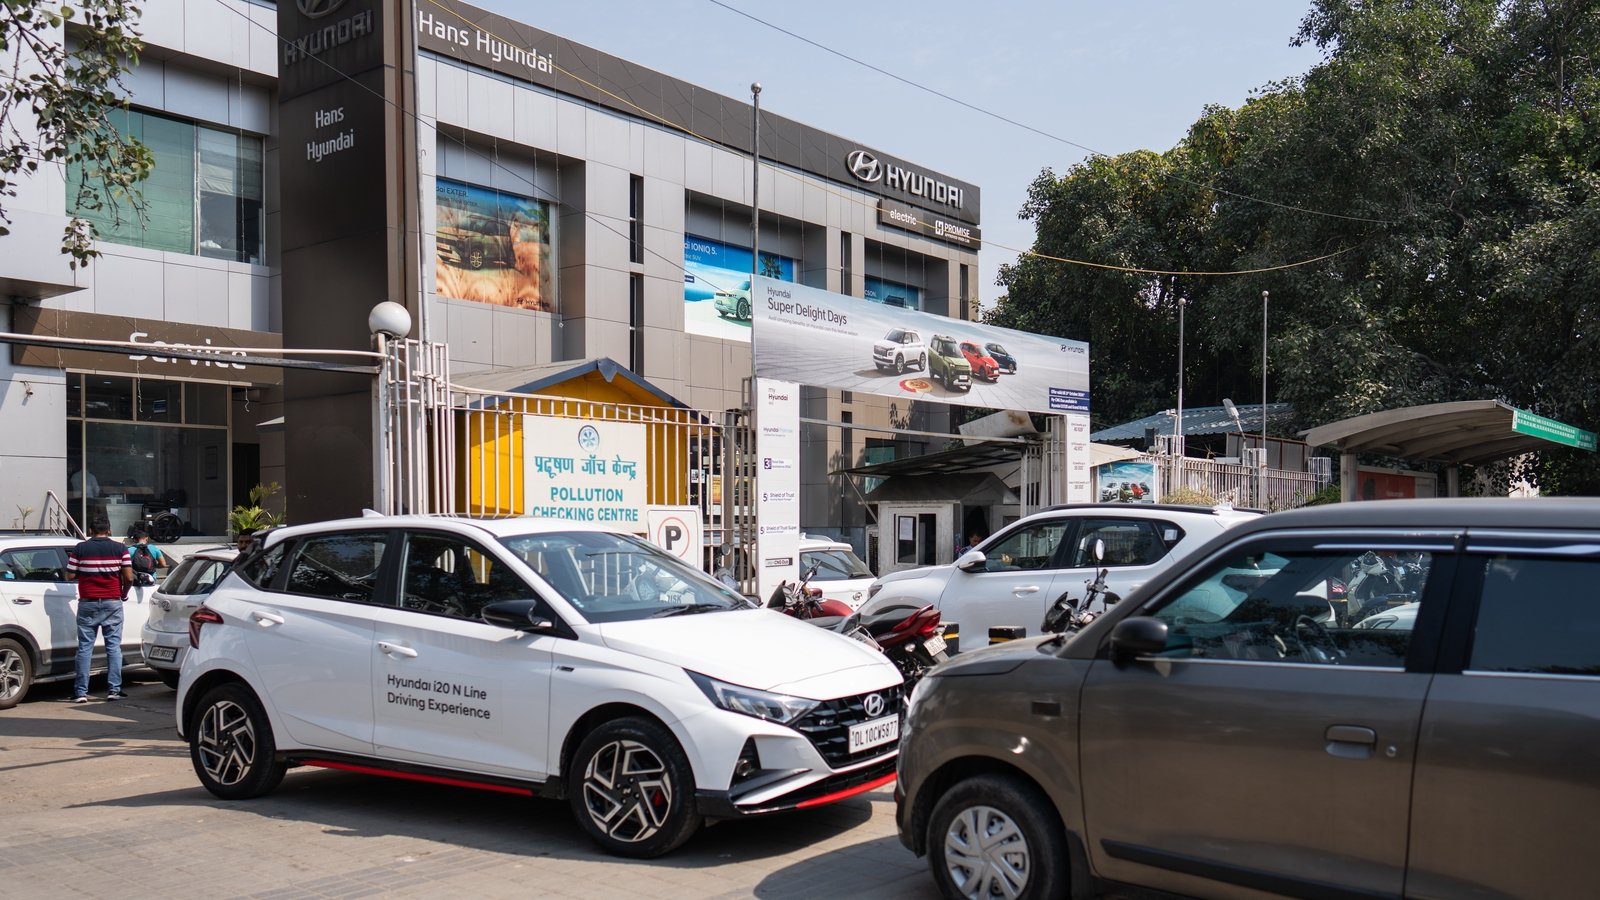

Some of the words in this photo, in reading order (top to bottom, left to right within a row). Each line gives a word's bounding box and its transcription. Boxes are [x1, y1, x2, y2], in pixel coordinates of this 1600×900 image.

[284, 9, 372, 65] HYUNDAI
[419, 10, 469, 46] Hans
[476, 29, 553, 74] Hyundai
[315, 107, 344, 128] Hans
[306, 128, 354, 162] Hyundai
[886, 163, 964, 208] HYUNDAI
[889, 208, 917, 225] electric
[944, 222, 971, 237] PROMISE
[691, 242, 711, 254] IONIQ
[767, 287, 791, 299] Hyundai
[768, 297, 794, 314] Super
[796, 303, 826, 321] Delight
[828, 310, 847, 326] Days
[550, 486, 624, 502] POLLUTION
[533, 505, 595, 521] CHECKING
[598, 507, 639, 522] CENTRE
[665, 525, 682, 551] P
[387, 674, 431, 691] Hyundai
[433, 680, 450, 694] i20
[453, 684, 461, 696] N
[464, 685, 487, 700] Line
[387, 692, 426, 711] Driving
[428, 698, 490, 720] Experience
